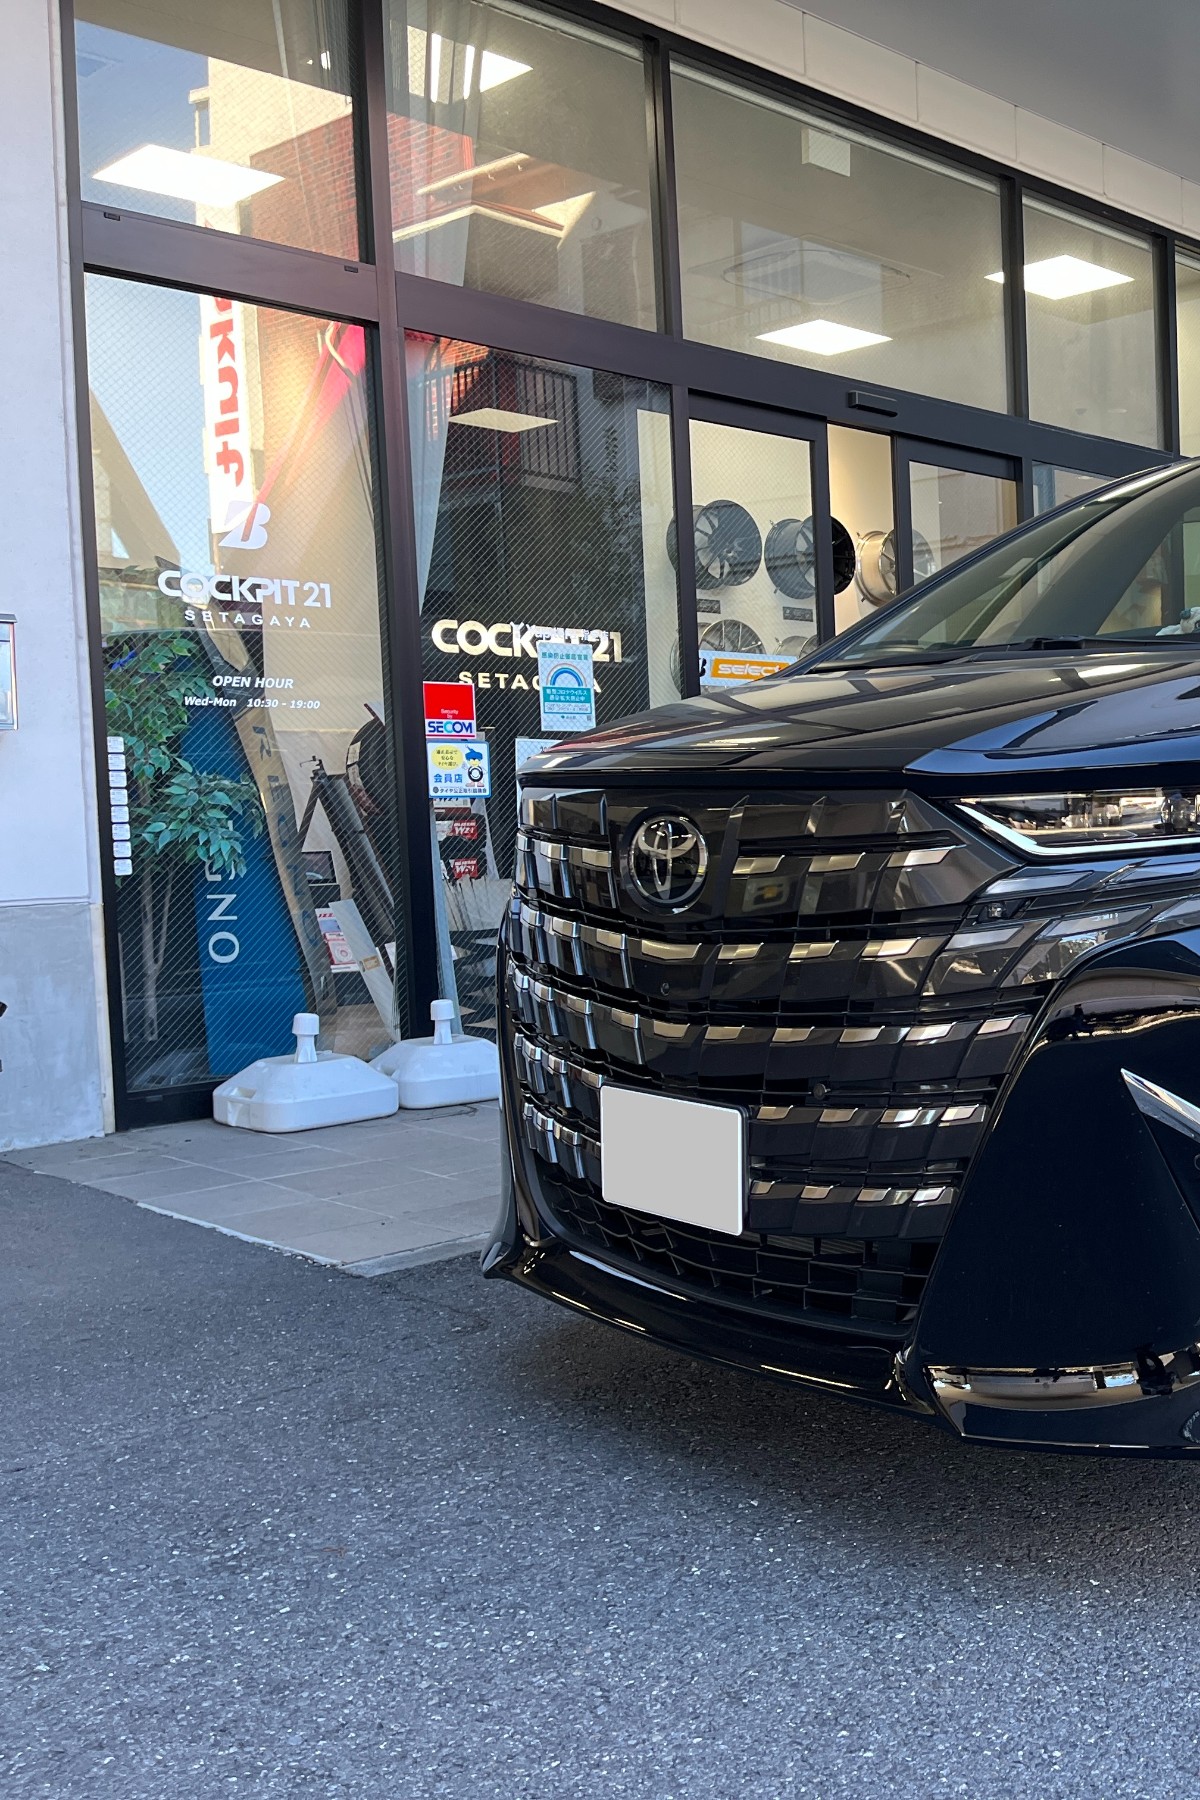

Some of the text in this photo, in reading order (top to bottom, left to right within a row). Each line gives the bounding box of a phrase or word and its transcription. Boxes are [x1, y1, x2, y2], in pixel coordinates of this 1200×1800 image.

[184, 609, 311, 629] SETAGAYA
[212, 675, 294, 689] OPEN HOUR
[184, 696, 237, 707] Wed-Mon
[247, 698, 278, 708] 10:30
[289, 699, 321, 710] 19:00
[427, 721, 473, 734] SECOM
[433, 773, 463, 783] 会員店
